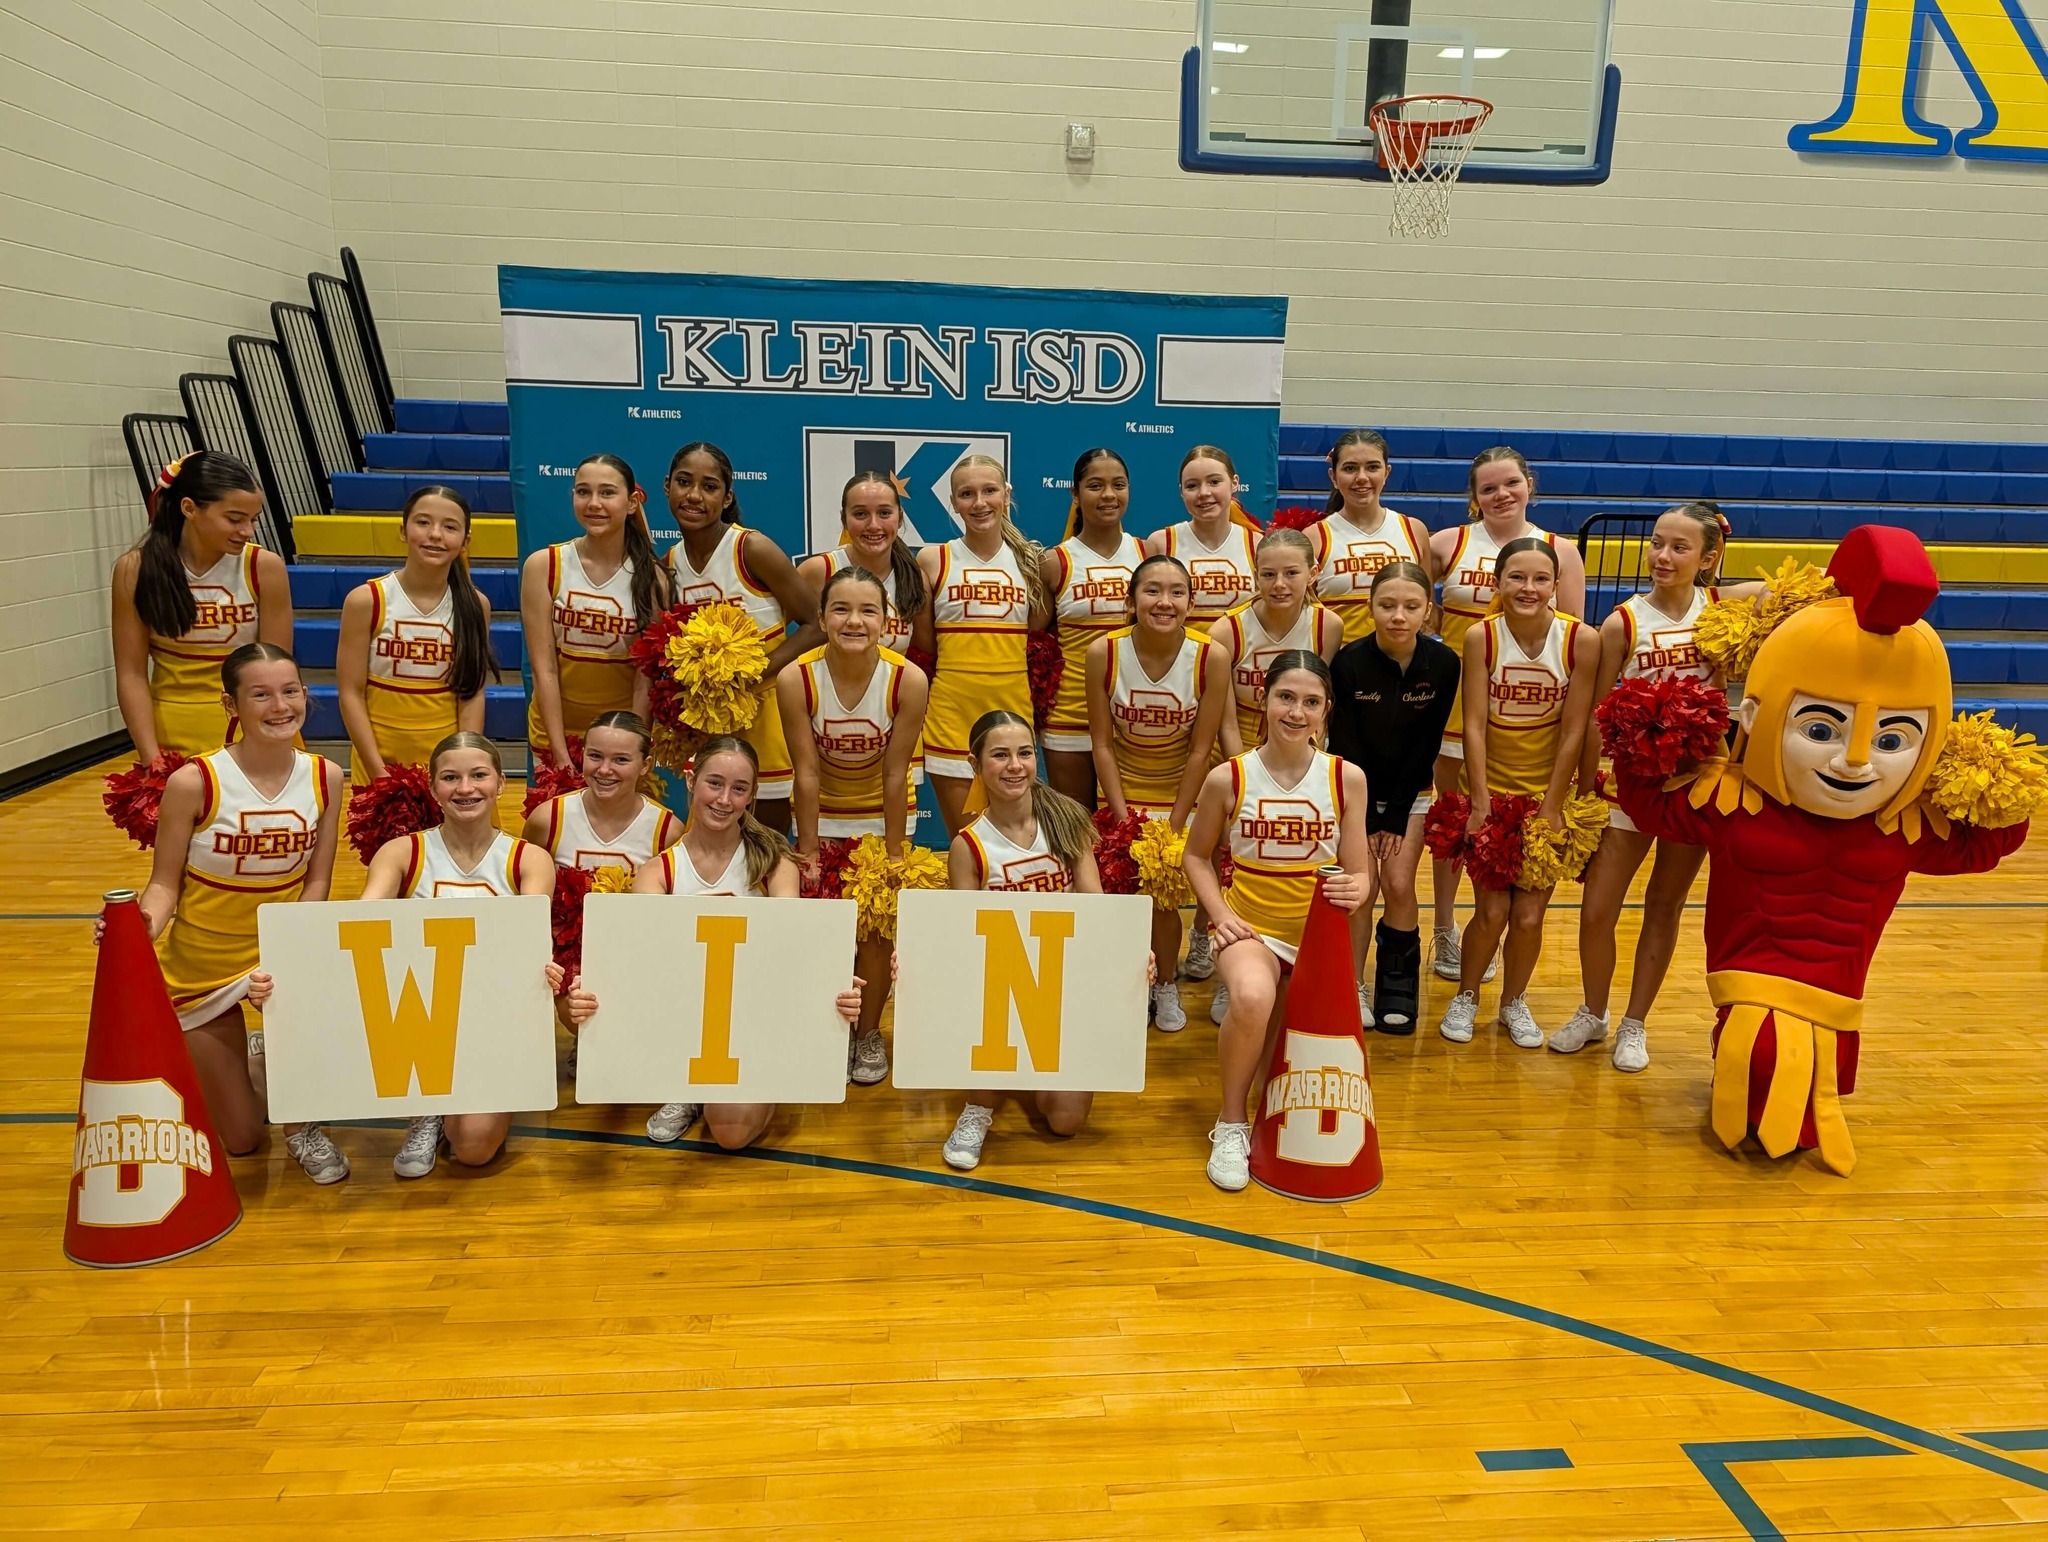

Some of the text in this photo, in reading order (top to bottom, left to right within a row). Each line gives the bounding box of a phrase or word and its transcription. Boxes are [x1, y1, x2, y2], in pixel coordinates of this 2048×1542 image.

[656, 315, 1145, 404] KLEIN ISD
[642, 409, 682, 419] ATHLETICS
[1138, 424, 1174, 434] ATHLETICS
[553, 467, 577, 477] ATHLE
[732, 471, 768, 481] THLETICS
[948, 584, 1026, 605] DOERRE
[1072, 580, 1131, 601] DOER
[1191, 575, 1252, 593] OERRE
[376, 638, 455, 662] DOERR
[1637, 646, 1709, 672] DOER
[1114, 702, 1197, 726] DOERRE
[1240, 819, 1335, 841] DOERRE
[689, 915, 747, 1085] I
[970, 909, 1075, 1073] N
[338, 917, 476, 1098] W
